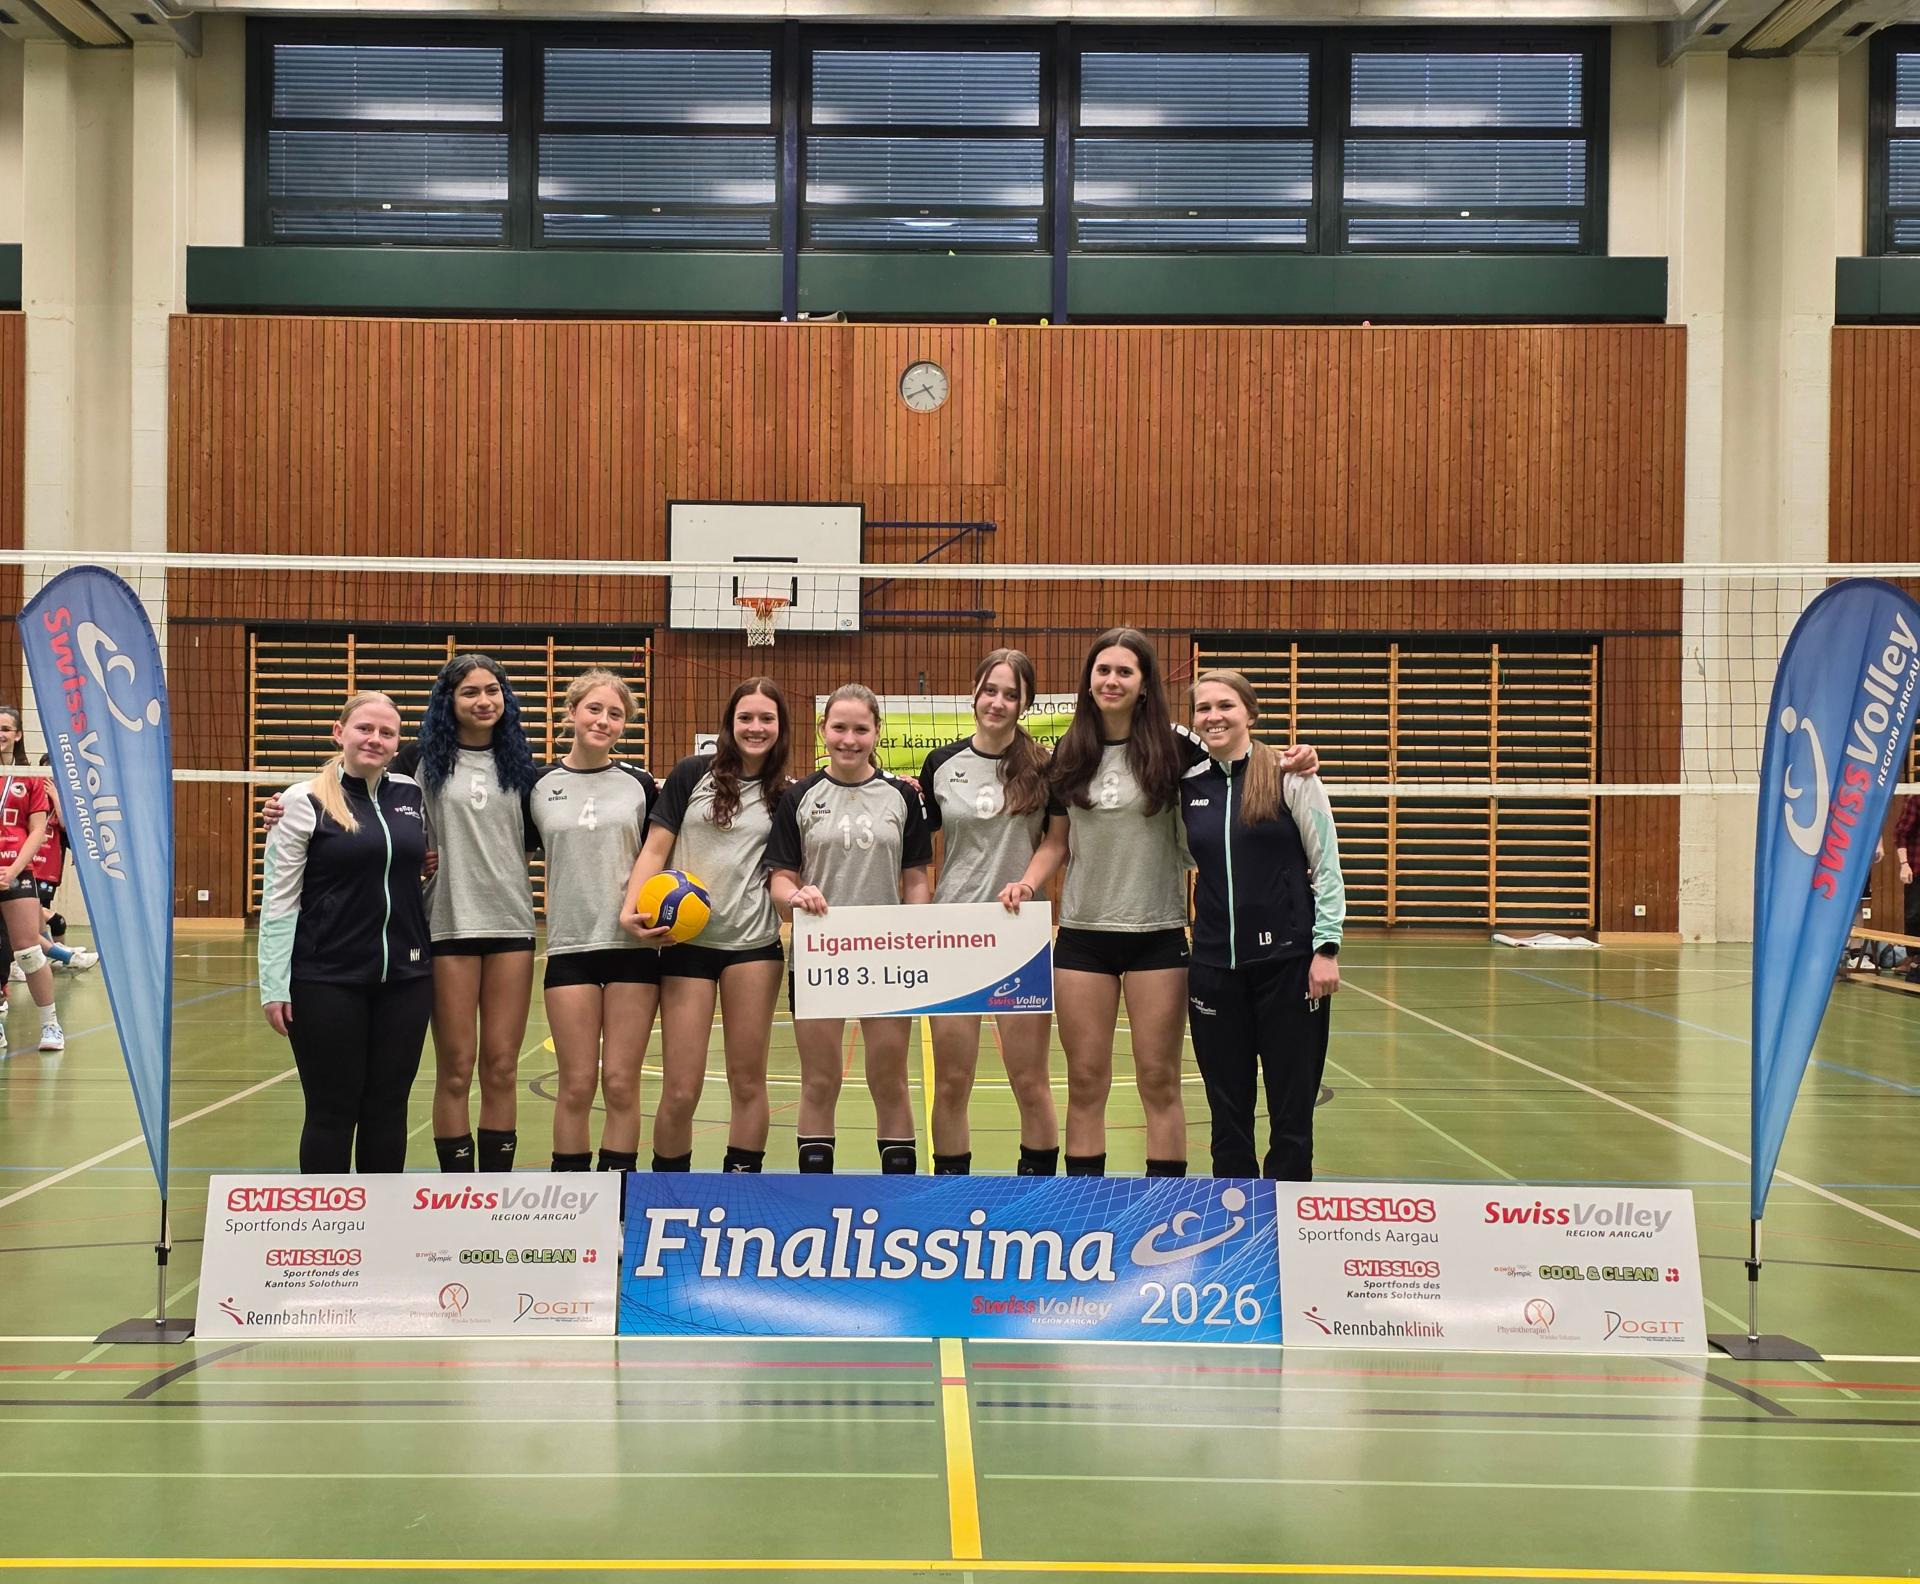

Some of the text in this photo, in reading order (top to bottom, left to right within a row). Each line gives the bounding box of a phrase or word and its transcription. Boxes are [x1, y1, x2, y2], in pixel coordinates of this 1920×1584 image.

[1877, 658, 1920, 787] REGION AARGAU
[875, 737, 898, 748] er
[58, 733, 100, 860] REGION AARGAU
[469, 774, 488, 811] 5
[975, 785, 996, 819] 6
[1190, 798, 1209, 806] JAKO
[578, 797, 598, 831] 4
[837, 814, 875, 850] 13
[806, 930, 997, 957] Ligameisterinnen
[1259, 932, 1272, 945] LB
[807, 966, 929, 988] U18 3. Liga
[1310, 998, 1319, 1012] LB
[227, 1187, 366, 1212] SWISSLOS
[413, 1185, 599, 1215] SwissVolley
[491, 1213, 577, 1221] REGION AARGAU
[1297, 1196, 1436, 1223] SWISSLOS
[1484, 1201, 1672, 1232] SwissVolley
[225, 1218, 365, 1235] Sportfonds Aargau
[1566, 1229, 1654, 1239] REGION AARGAU
[634, 1206, 1116, 1282] Finalissima
[1298, 1227, 1439, 1246] Sportfonds Aargau
[266, 1248, 362, 1266] SWISSLOS
[459, 1249, 577, 1264] COOL & CLEAN
[283, 1268, 360, 1279] Sportfonds des
[1344, 1260, 1441, 1278] SWISSLOS
[1539, 1265, 1659, 1282] COOL & CLEAN
[265, 1279, 359, 1288] Kantons Solothurn
[1363, 1280, 1441, 1291] Sportfonds des
[1138, 1281, 1262, 1326] 2026
[1346, 1290, 1441, 1300] Kantons Solothurn
[247, 1309, 357, 1326] Rennbahnklinik
[1334, 1320, 1445, 1338] Rennbahnklinik
